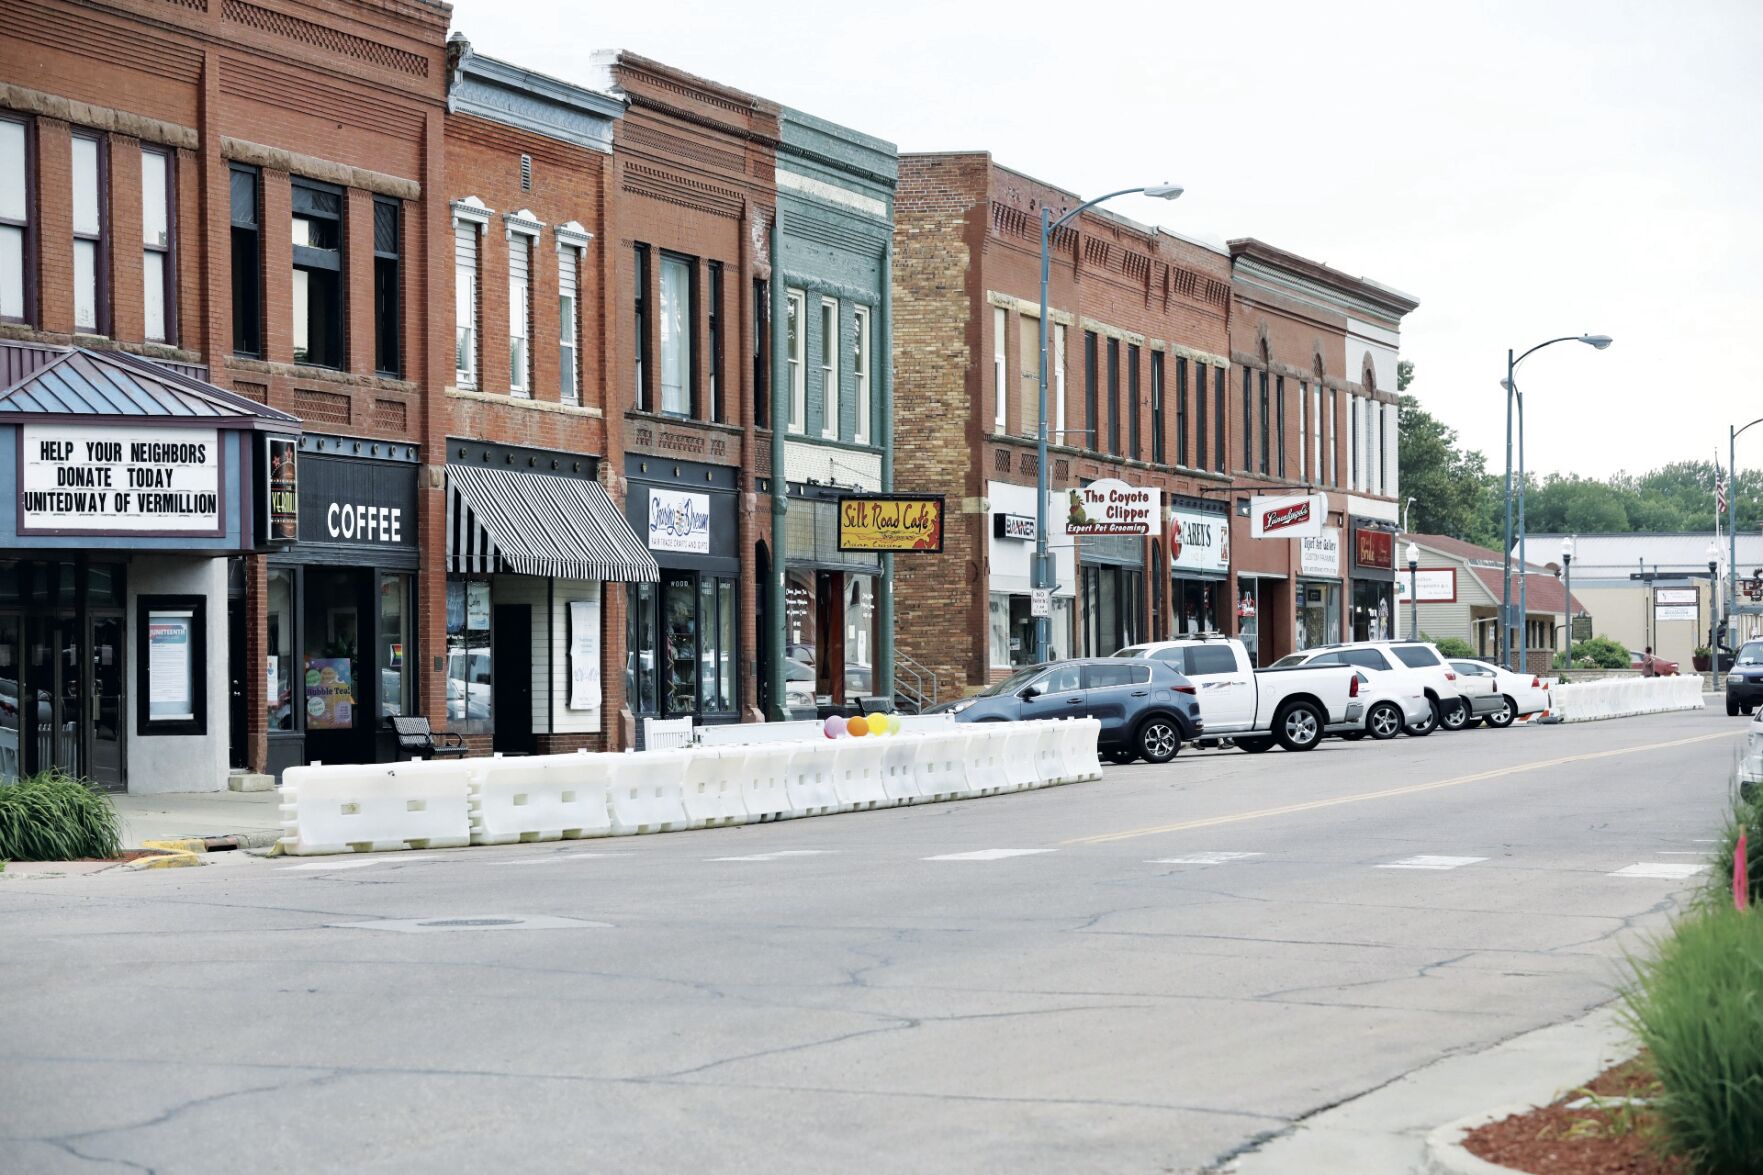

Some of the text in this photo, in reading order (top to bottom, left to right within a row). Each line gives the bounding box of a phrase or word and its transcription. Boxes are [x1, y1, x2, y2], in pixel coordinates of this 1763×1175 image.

[40, 441, 206, 464] HELP YOUR NEIGHBORS
[57, 467, 173, 488] DONATE TODAY
[114, 493, 131, 513] OF
[138, 494, 217, 514] VERMILLION
[1084, 489, 1149, 507] The Coyote
[327, 502, 401, 542] COFFEE
[843, 502, 929, 533] Silk Road Café
[1106, 505, 1149, 522] Clipper
[1007, 518, 1035, 537] BANNER
[1067, 524, 1146, 534] Expert Pet Grooming
[670, 580, 689, 588] WOOD
